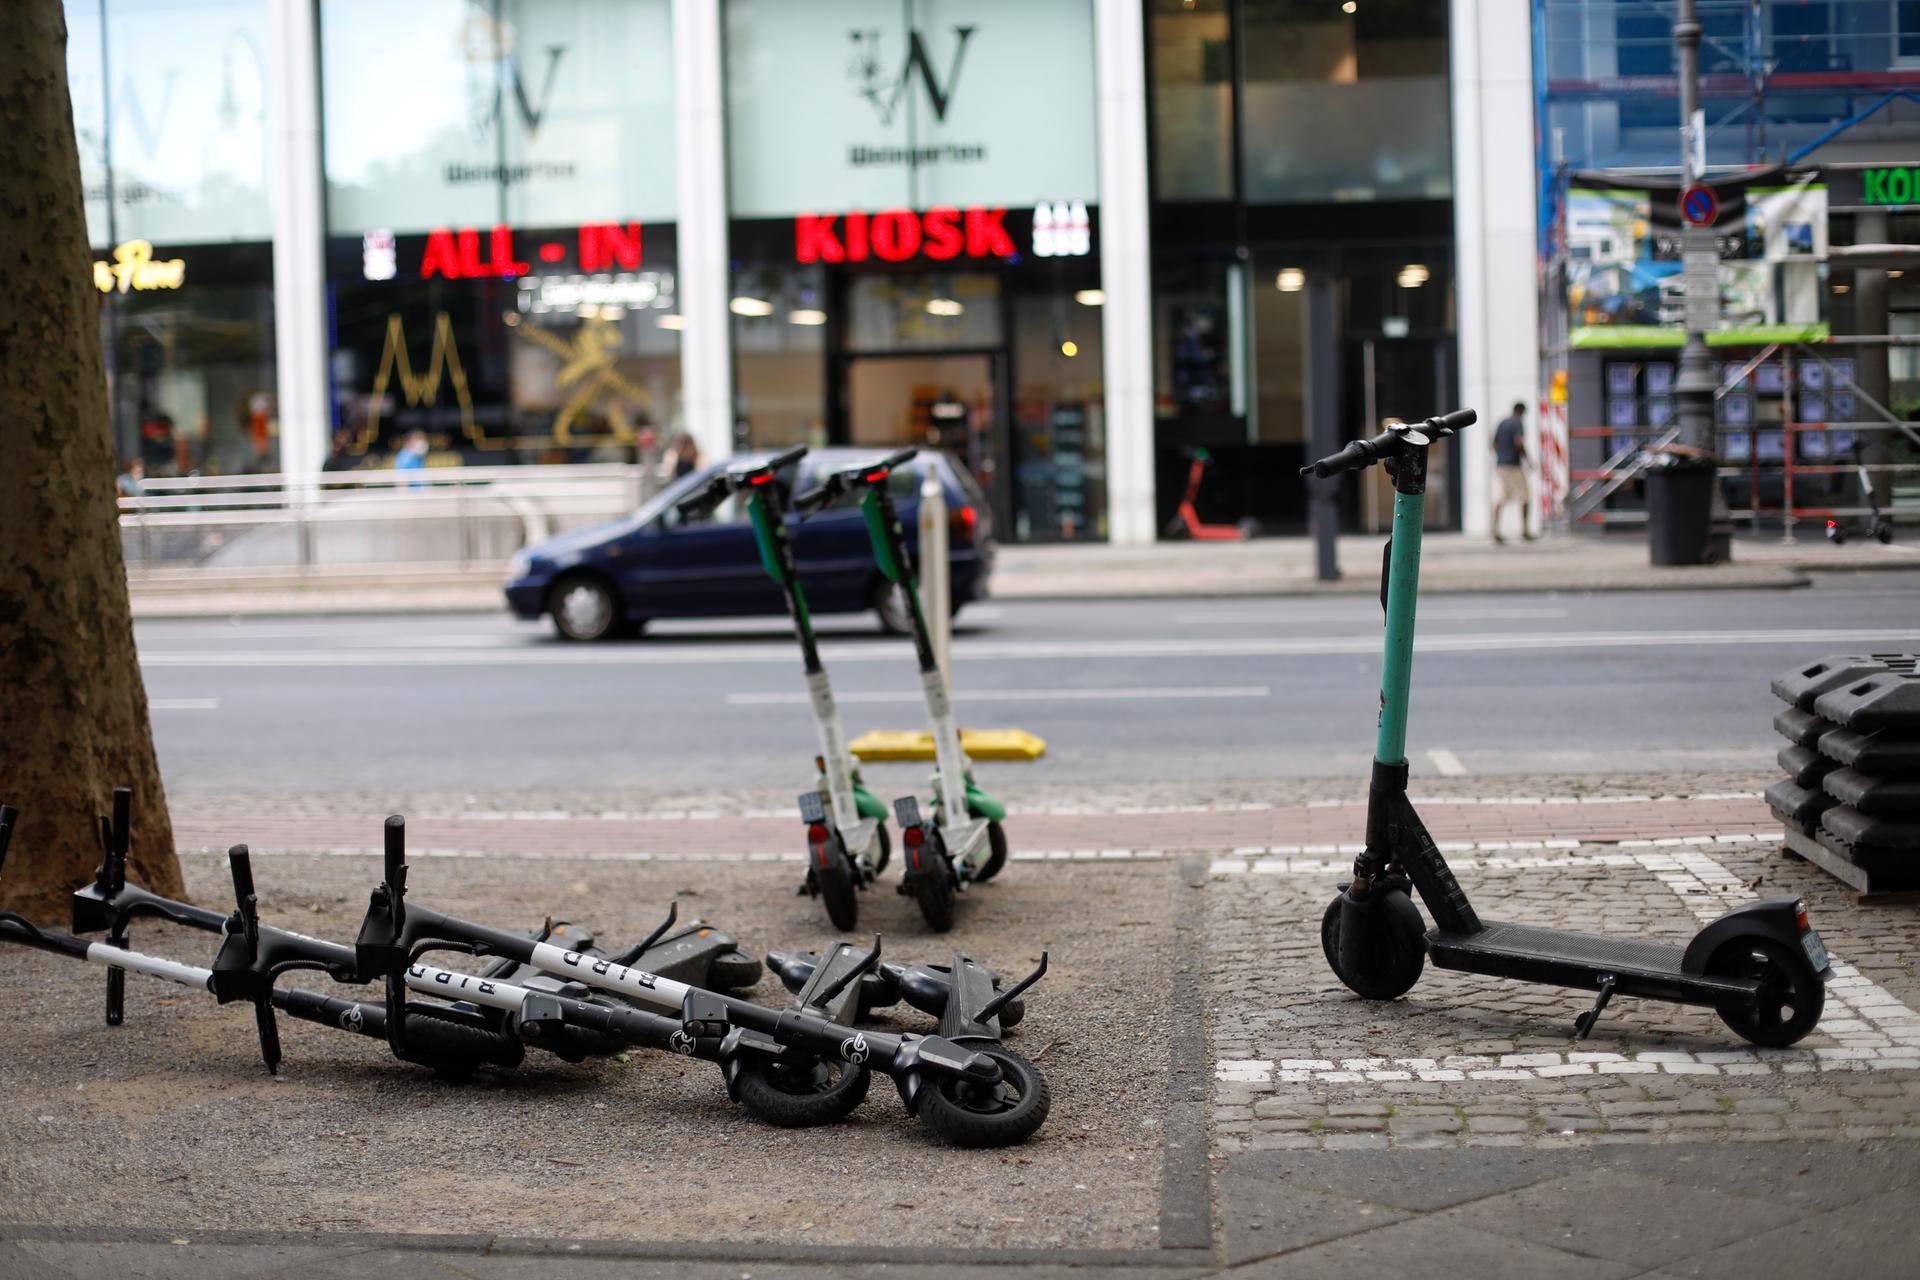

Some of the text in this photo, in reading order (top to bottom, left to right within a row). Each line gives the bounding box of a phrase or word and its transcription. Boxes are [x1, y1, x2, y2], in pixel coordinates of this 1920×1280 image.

[419, 225, 530, 279] ALL
[578, 220, 642, 272] IN
[796, 204, 1017, 263] KIOSK
[563, 951, 658, 990] BIRD
